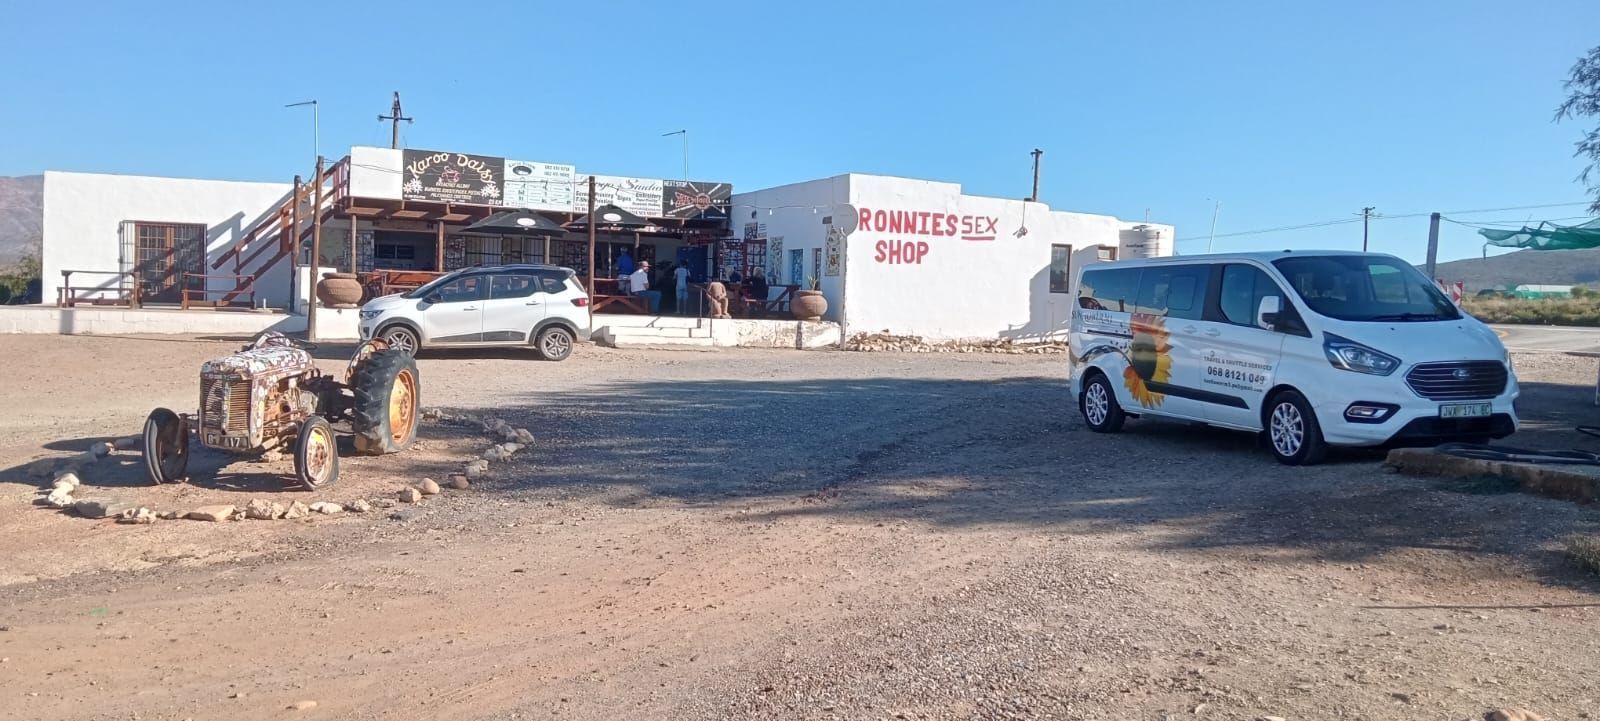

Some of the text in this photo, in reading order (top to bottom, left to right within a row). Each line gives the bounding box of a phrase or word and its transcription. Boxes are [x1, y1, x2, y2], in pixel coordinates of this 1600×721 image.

[406, 152, 496, 184] Karoo Daisy
[859, 207, 998, 237] RONNIES SEX
[874, 239, 929, 264] SHOP
[1207, 366, 1223, 376] 068
[1224, 369, 1246, 381] 8121
